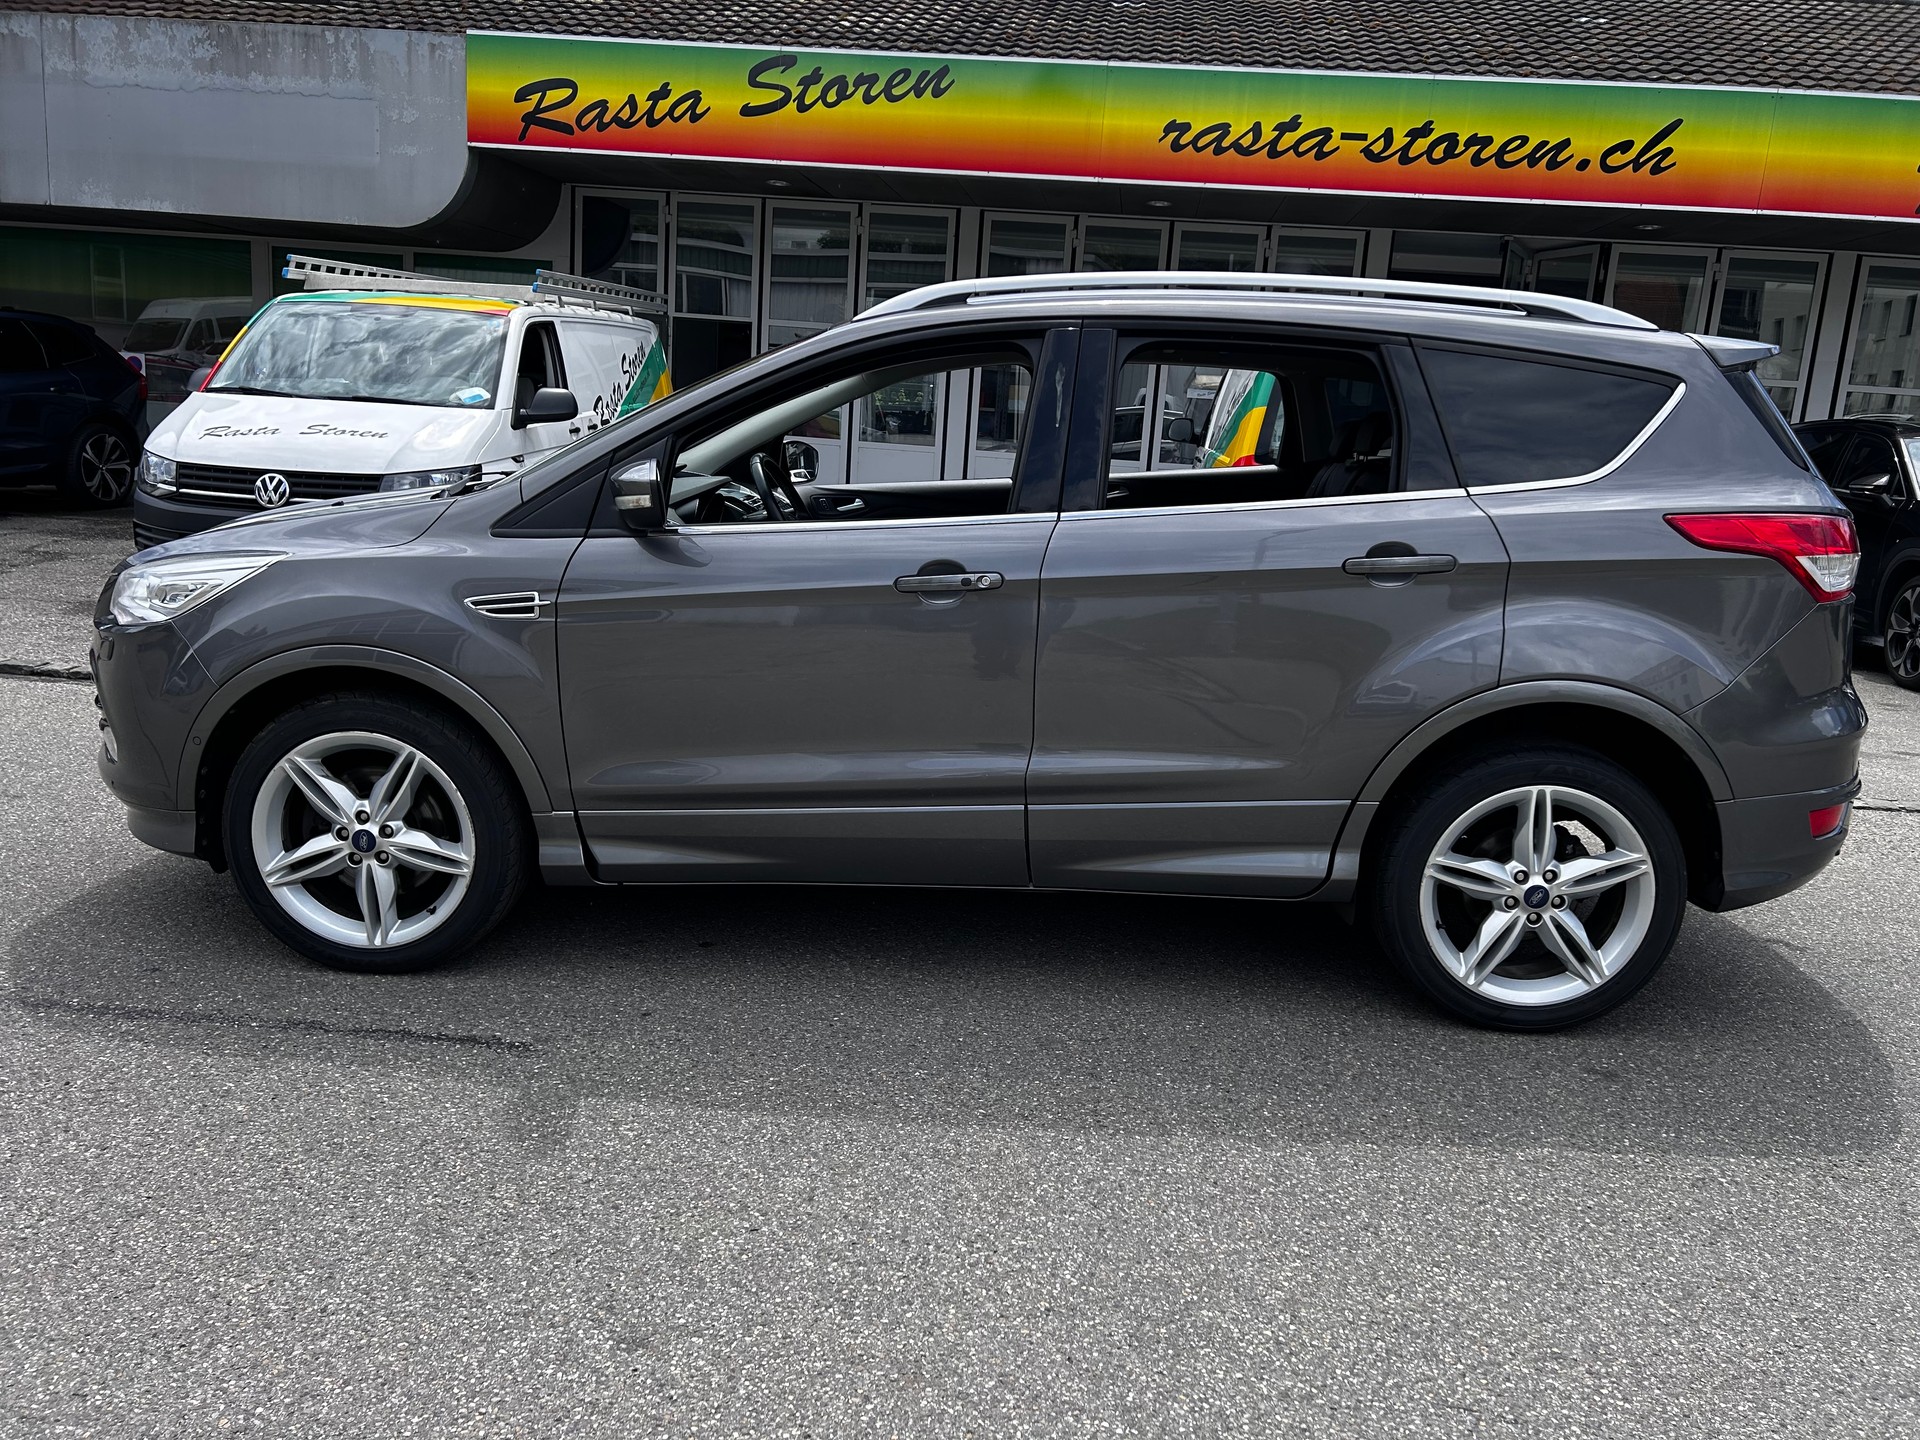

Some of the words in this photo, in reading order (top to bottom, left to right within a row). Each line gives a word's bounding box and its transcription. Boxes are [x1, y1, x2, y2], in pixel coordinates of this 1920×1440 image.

[513, 77, 711, 143] Rasta
[739, 53, 956, 118] Storen
[1158, 114, 1685, 176] rasta-storen.ch
[592, 381, 624, 427] Rasta
[620, 340, 647, 392] Storen
[198, 425, 282, 440] Rasta
[298, 424, 389, 439] Storen
